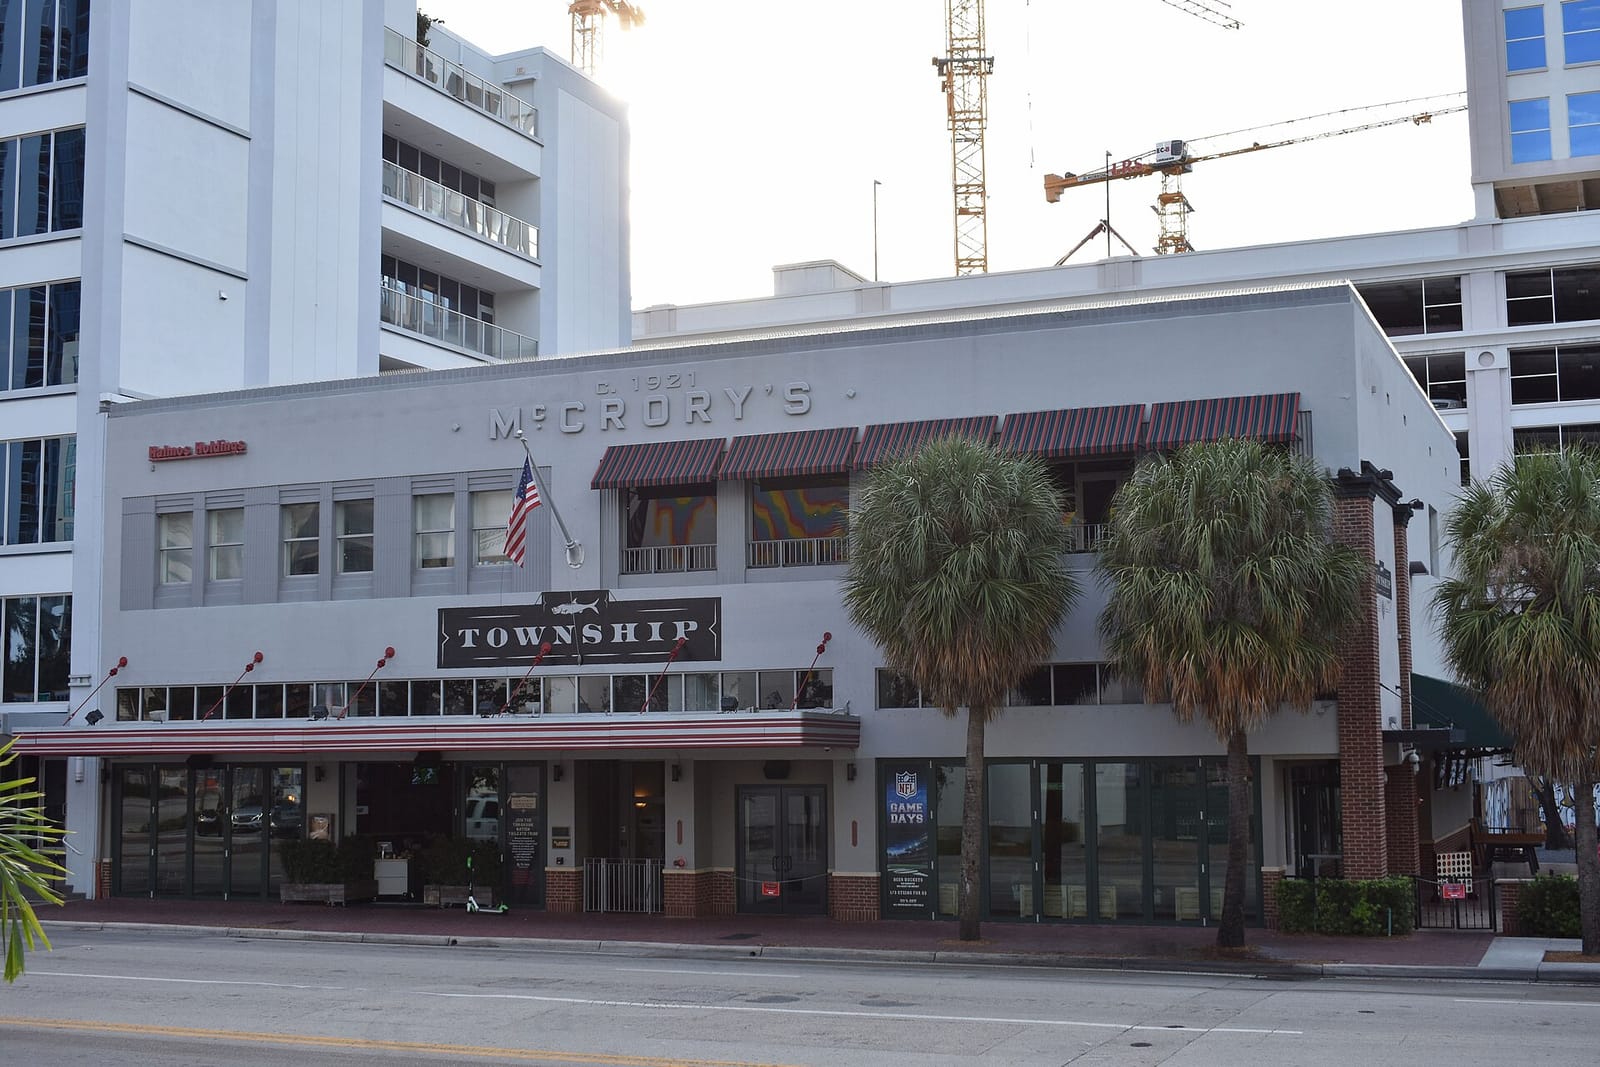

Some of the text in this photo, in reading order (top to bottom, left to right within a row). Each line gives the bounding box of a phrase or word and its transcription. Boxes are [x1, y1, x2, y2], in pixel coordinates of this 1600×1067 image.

[632, 371, 696, 392] 1921
[195, 439, 248, 456] Holdings
[457, 620, 699, 648] TOWNSHIP
[898, 783, 914, 795] NFL
[890, 803, 923, 813] GAME
[890, 813, 924, 824] DAYS
